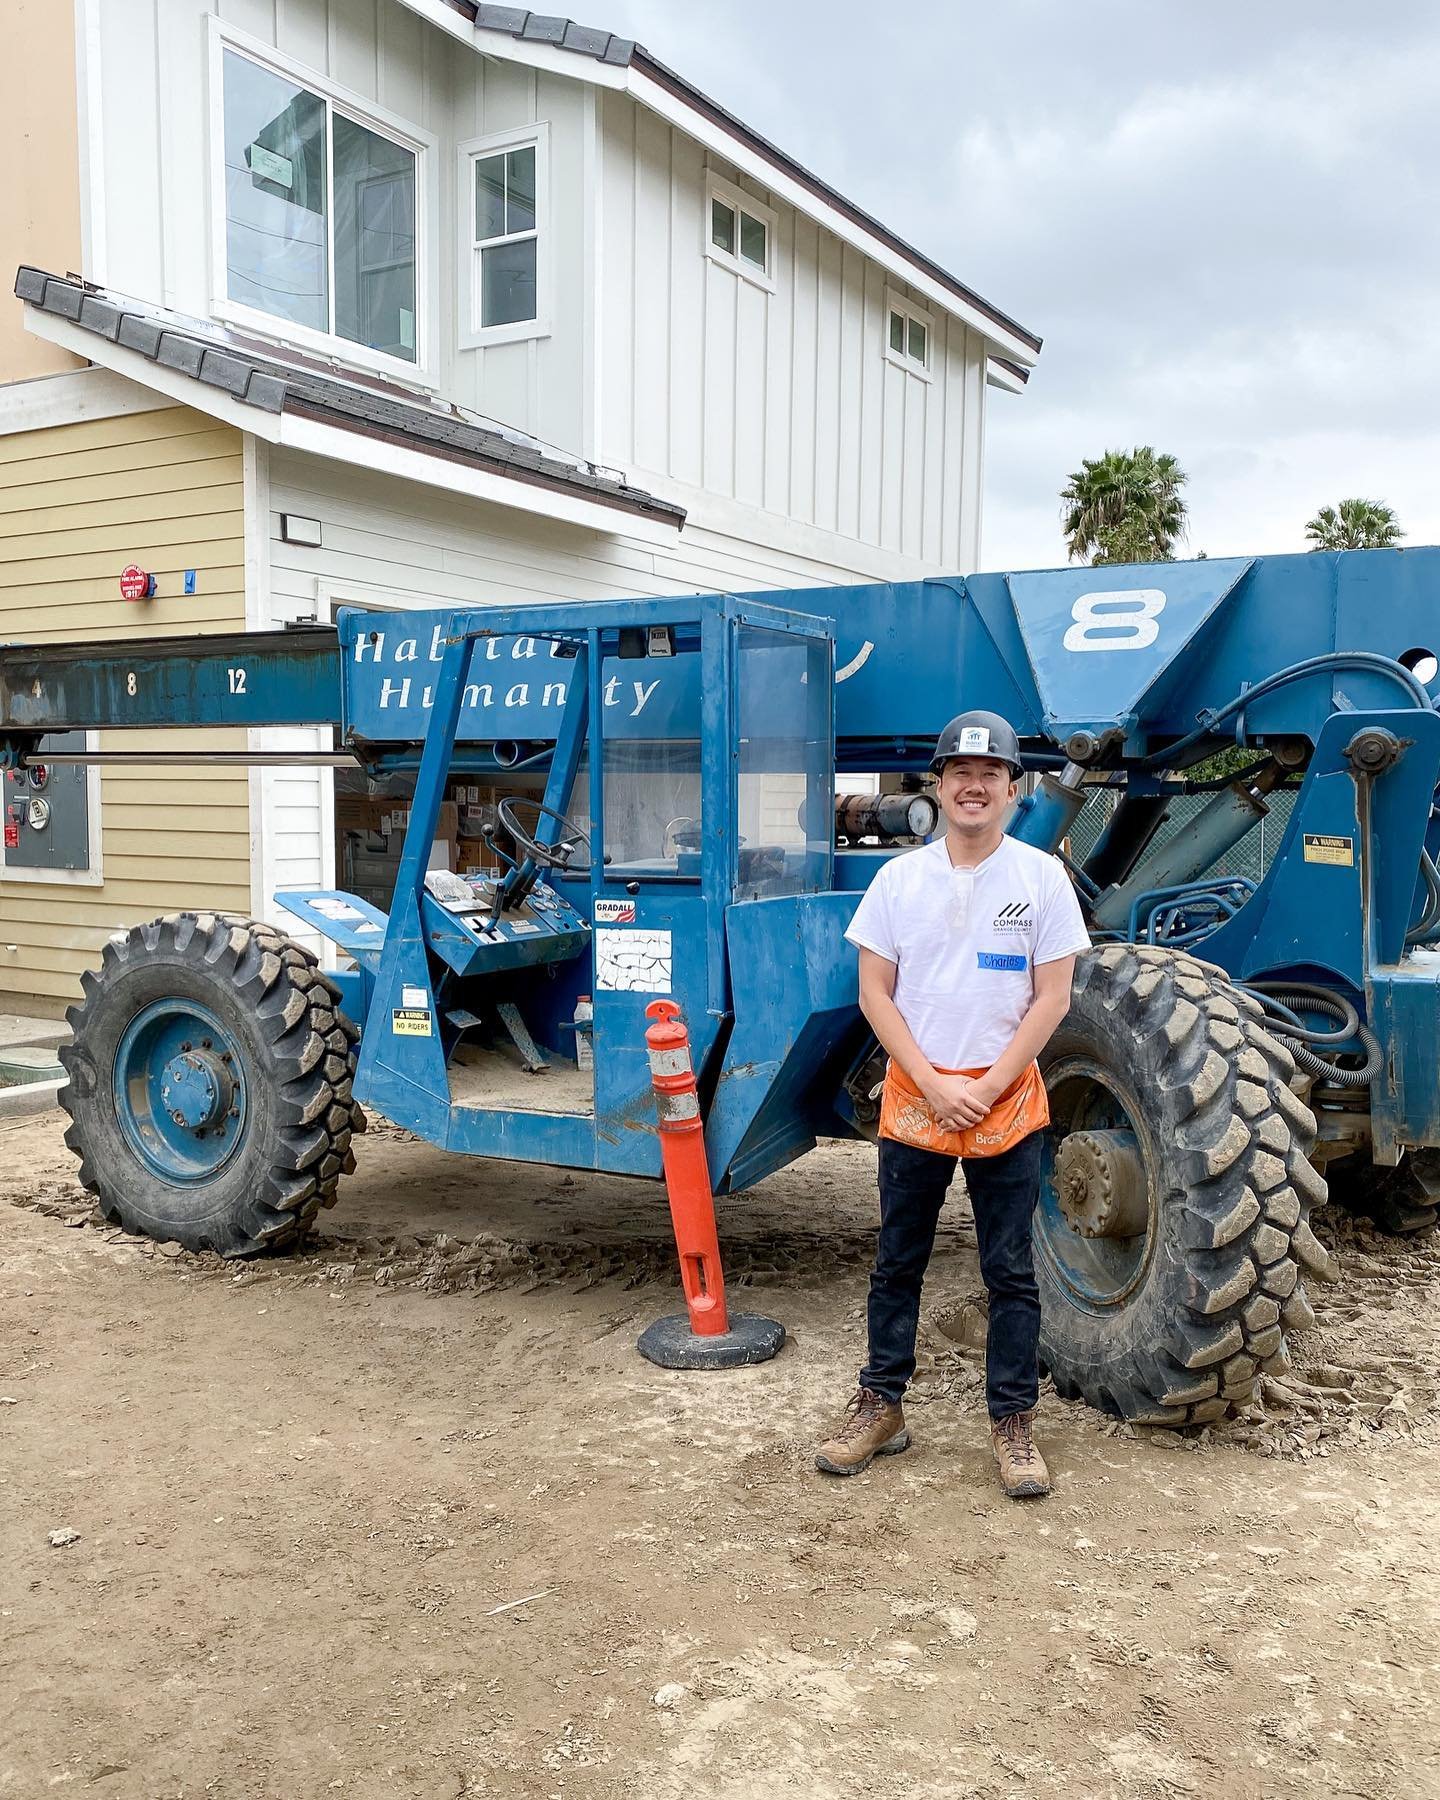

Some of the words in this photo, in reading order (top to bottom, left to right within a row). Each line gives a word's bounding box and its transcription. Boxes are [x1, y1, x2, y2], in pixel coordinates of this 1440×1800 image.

[1063, 589, 1167, 653] 8
[354, 624, 562, 663] Habta
[127, 672, 137, 696] 8
[227, 668, 247, 694] 12
[379, 675, 661, 717] Hmanty
[597, 903, 633, 912] GRADALL
[993, 919, 1033, 927] COMPASS
[396, 1022, 405, 1030] NO
[408, 1022, 429, 1031] RIDERS
